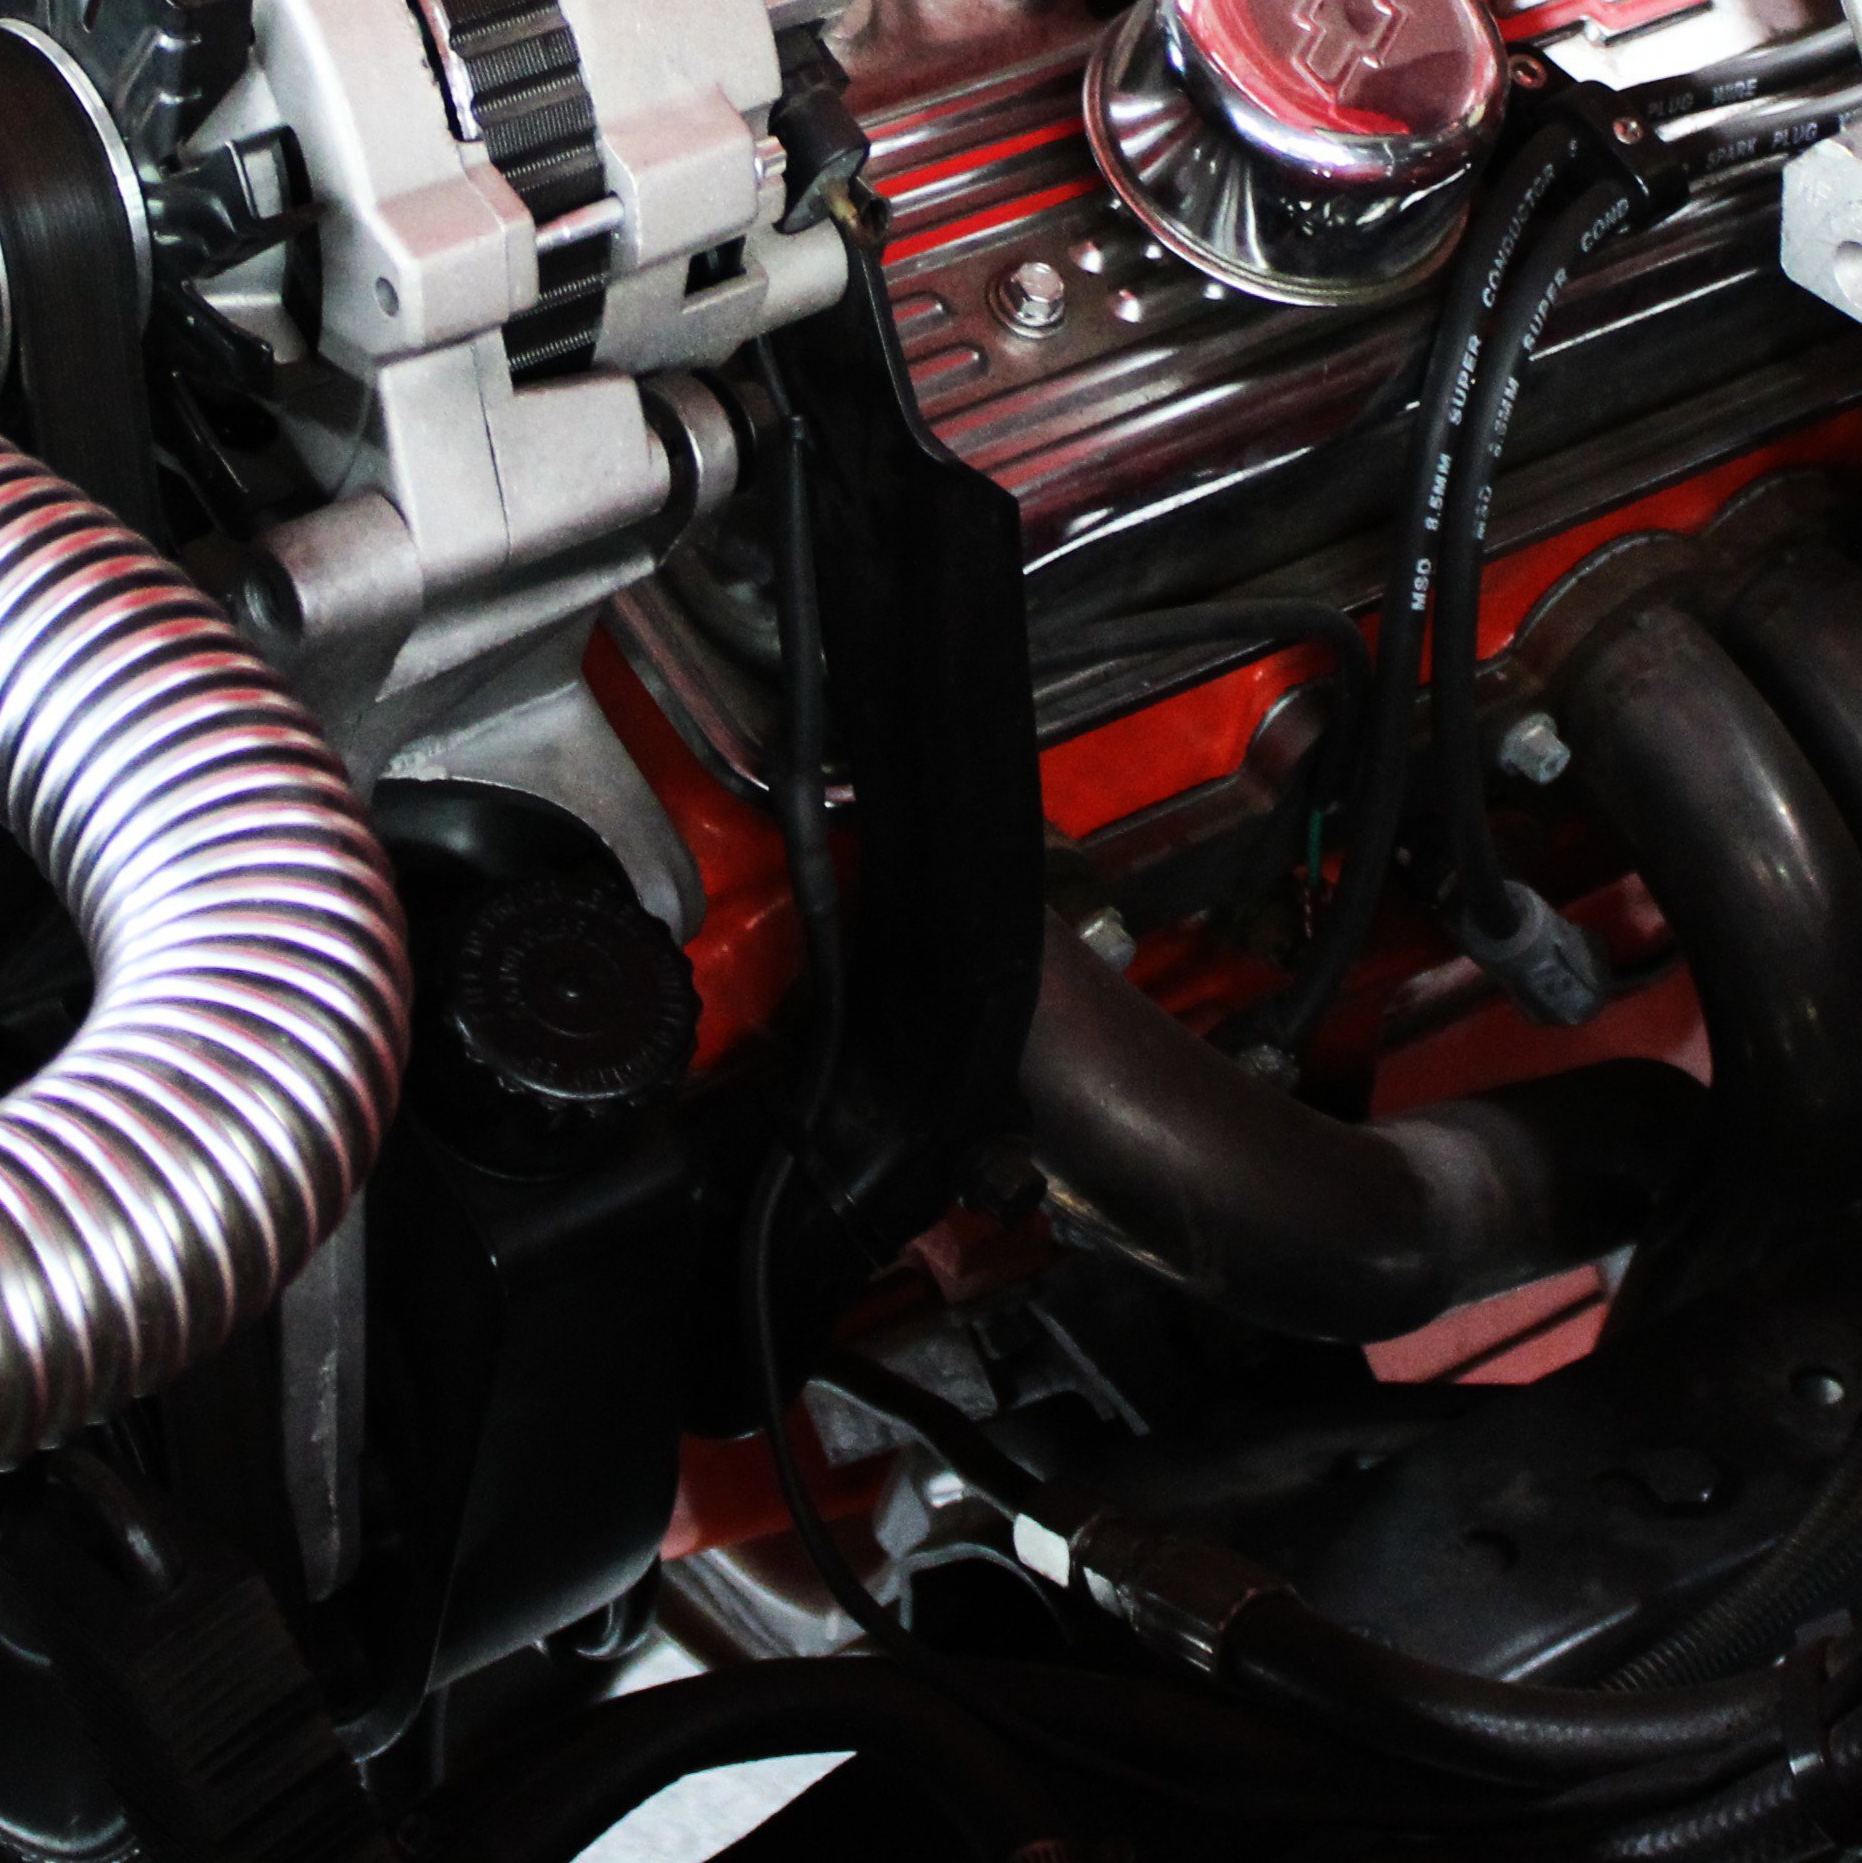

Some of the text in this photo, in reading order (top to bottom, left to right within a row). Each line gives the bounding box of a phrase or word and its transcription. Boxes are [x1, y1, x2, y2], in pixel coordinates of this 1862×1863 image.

[1771, 121, 1818, 150] PLUG
[1448, 334, 1482, 426] SUPER
[1481, 163, 1555, 309] CONDUCTOR
[1521, 267, 1568, 352] SUPER
